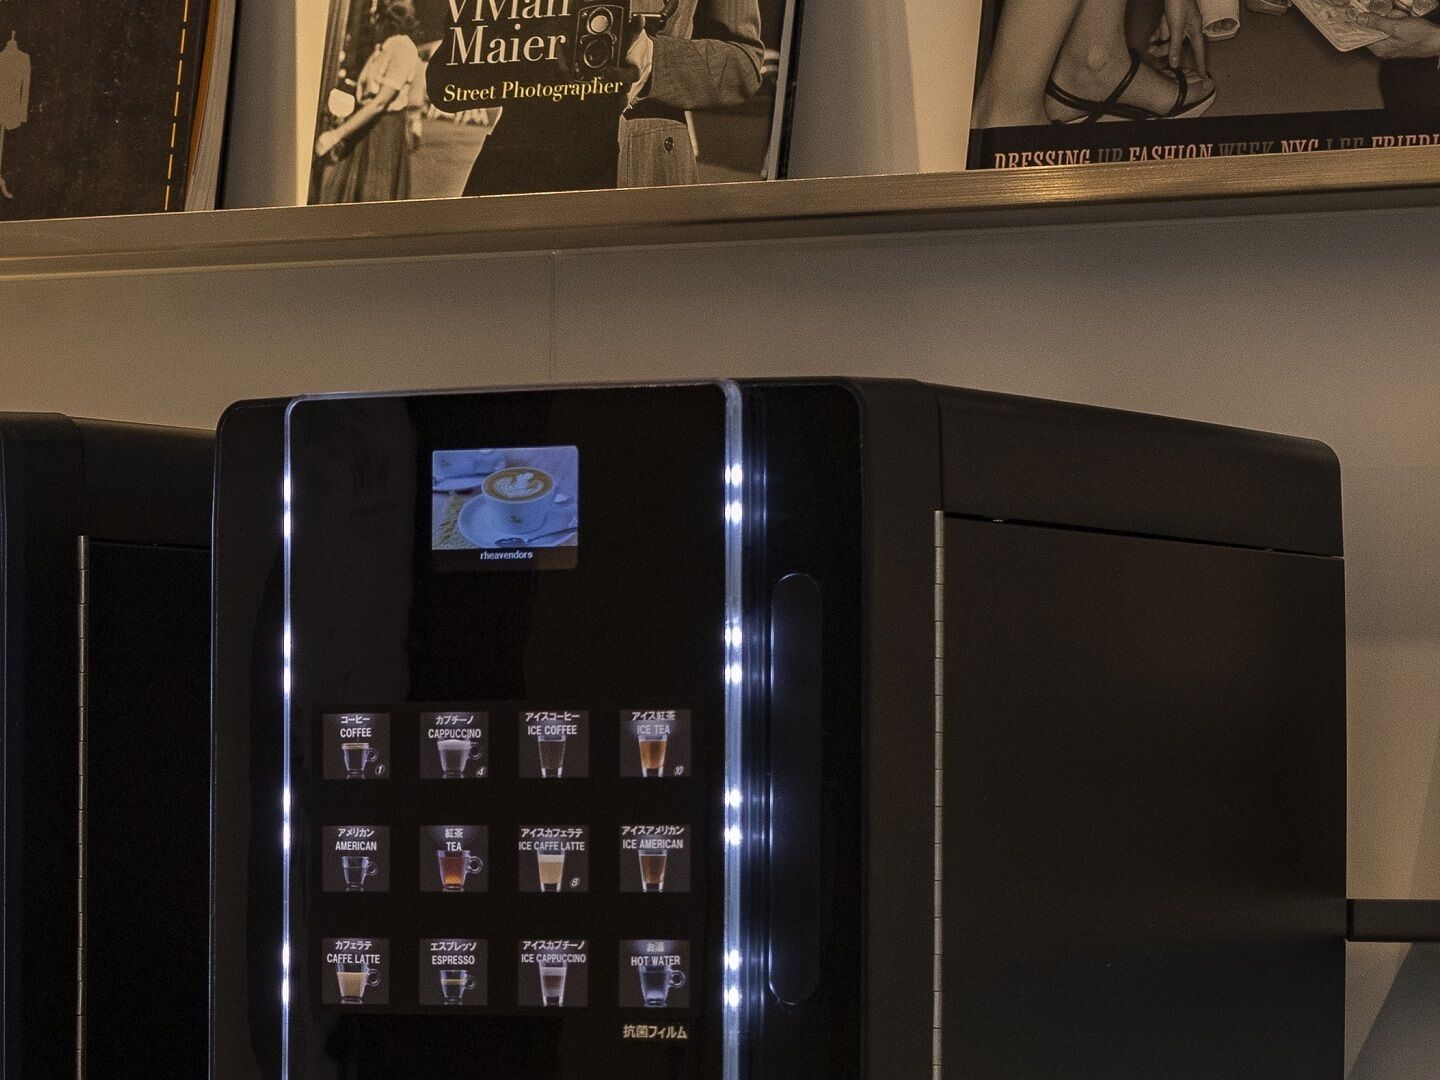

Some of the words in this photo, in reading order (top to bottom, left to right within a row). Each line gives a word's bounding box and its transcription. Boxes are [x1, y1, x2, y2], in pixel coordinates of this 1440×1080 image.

[446, 24, 566, 66] Maier
[444, 84, 496, 102] Street
[502, 77, 624, 102] Photographer
[480, 551, 533, 560] rheavendors
[341, 715, 370, 724] コーヒー
[436, 715, 475, 725] カプチーノ
[526, 712, 580, 722] アイスコーヒー
[632, 711, 676, 721] アイス紅茶
[340, 728, 372, 738] COFFEE
[428, 728, 482, 739] CAPPUCCINO
[528, 725, 542, 736] ICE
[545, 725, 577, 735] COFFEE
[637, 725, 650, 734] ICE
[655, 725, 671, 734] TEA
[338, 828, 374, 837] アメリカン
[445, 828, 463, 838] 紅茶
[521, 828, 583, 838] アイスカフェラテ
[622, 826, 685, 835] アイスアメリカン
[336, 841, 377, 851] AMERICAN
[446, 842, 462, 852] TEA
[519, 842, 532, 850] ICE
[534, 842, 559, 851] CAFFE
[561, 842, 585, 851] LATTE
[623, 840, 636, 849] ICE
[639, 839, 683, 849] AMERICAN
[335, 940, 372, 950] カフェラテ
[431, 942, 476, 951] エスプレッソ
[523, 941, 585, 951] アイスカプチーノ
[327, 954, 353, 963] CAFFE
[355, 955, 380, 964] LATTE
[432, 955, 475, 965] ESPRESSO
[521, 954, 534, 963] ICE
[536, 954, 586, 964] CAPPUCCINO
[631, 956, 650, 966] HOT
[652, 956, 680, 966] WATER
[623, 1024, 688, 1039] 抗菌フィルム
